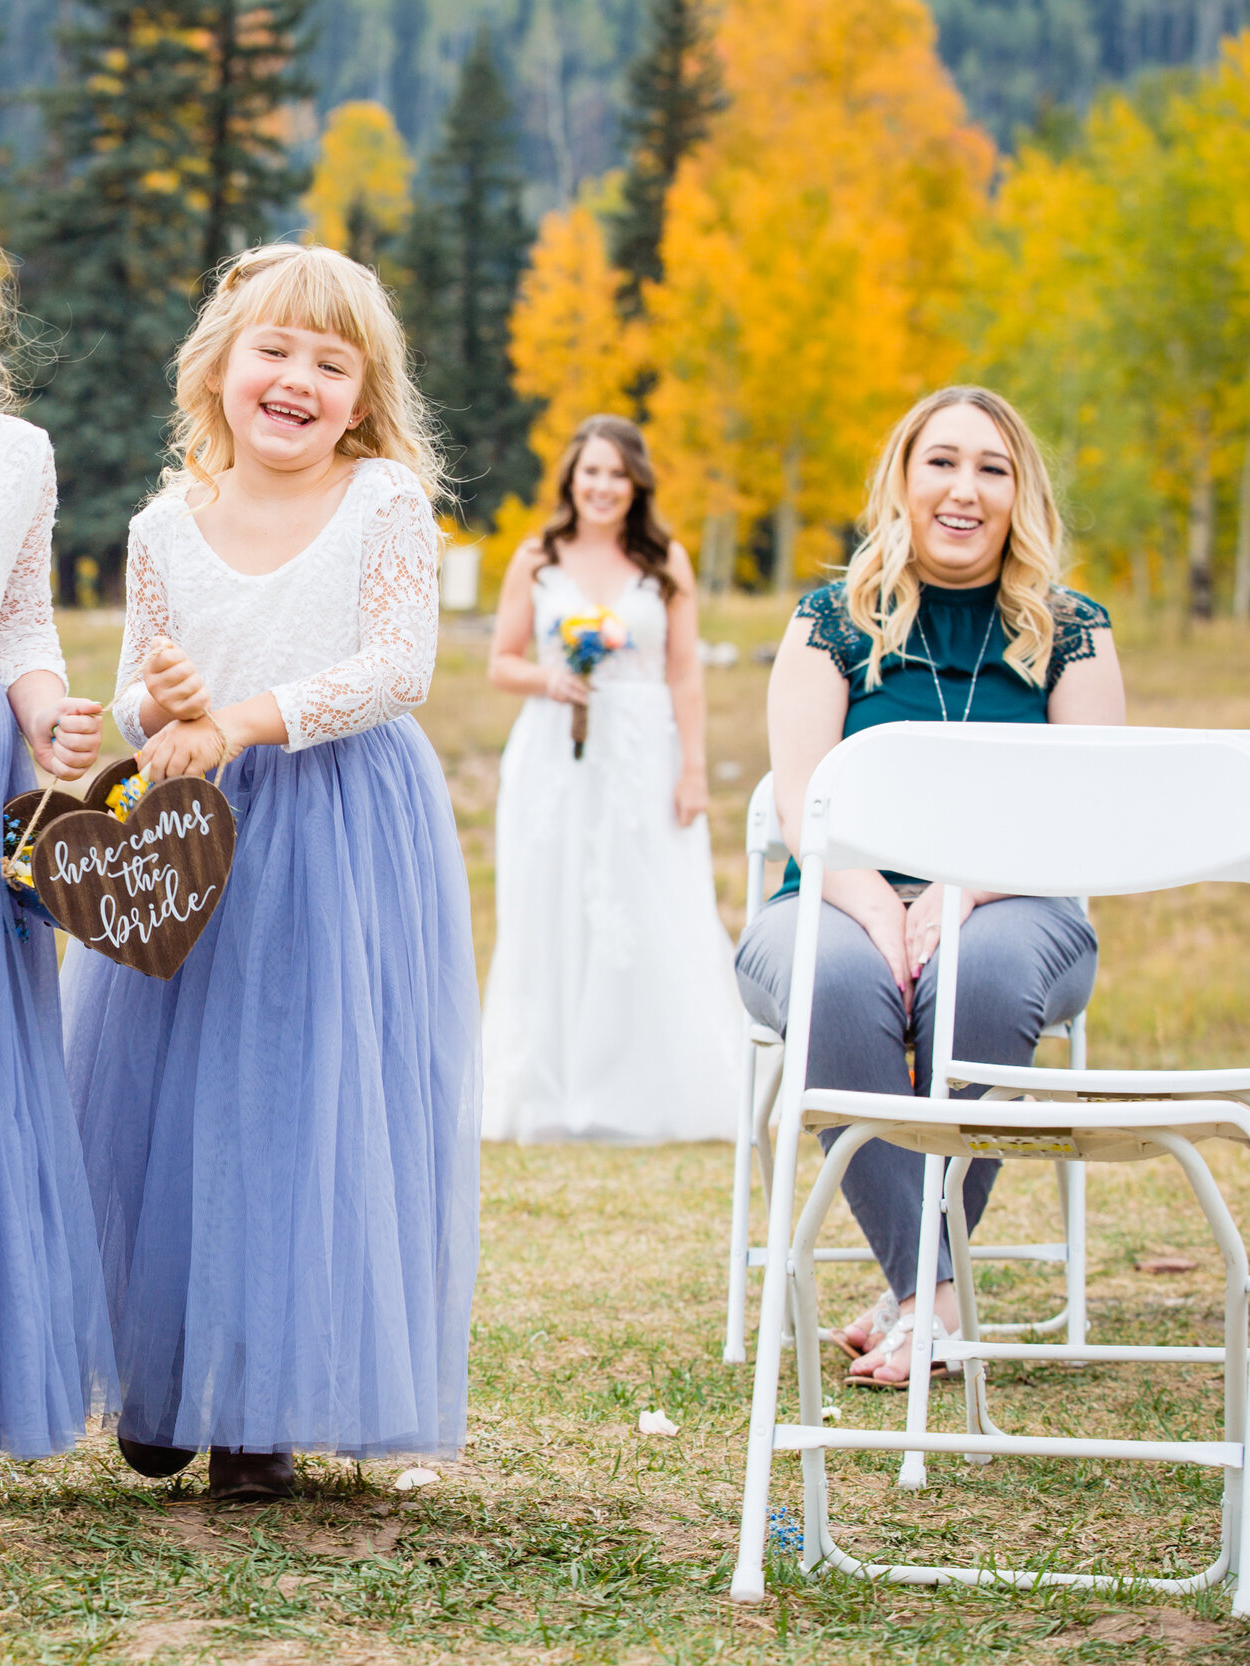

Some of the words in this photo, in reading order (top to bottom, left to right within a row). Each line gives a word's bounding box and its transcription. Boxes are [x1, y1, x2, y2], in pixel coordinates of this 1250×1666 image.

[50, 840, 128, 885] here
[129, 799, 215, 850] comes
[107, 852, 171, 898] the
[89, 868, 217, 949] bride
